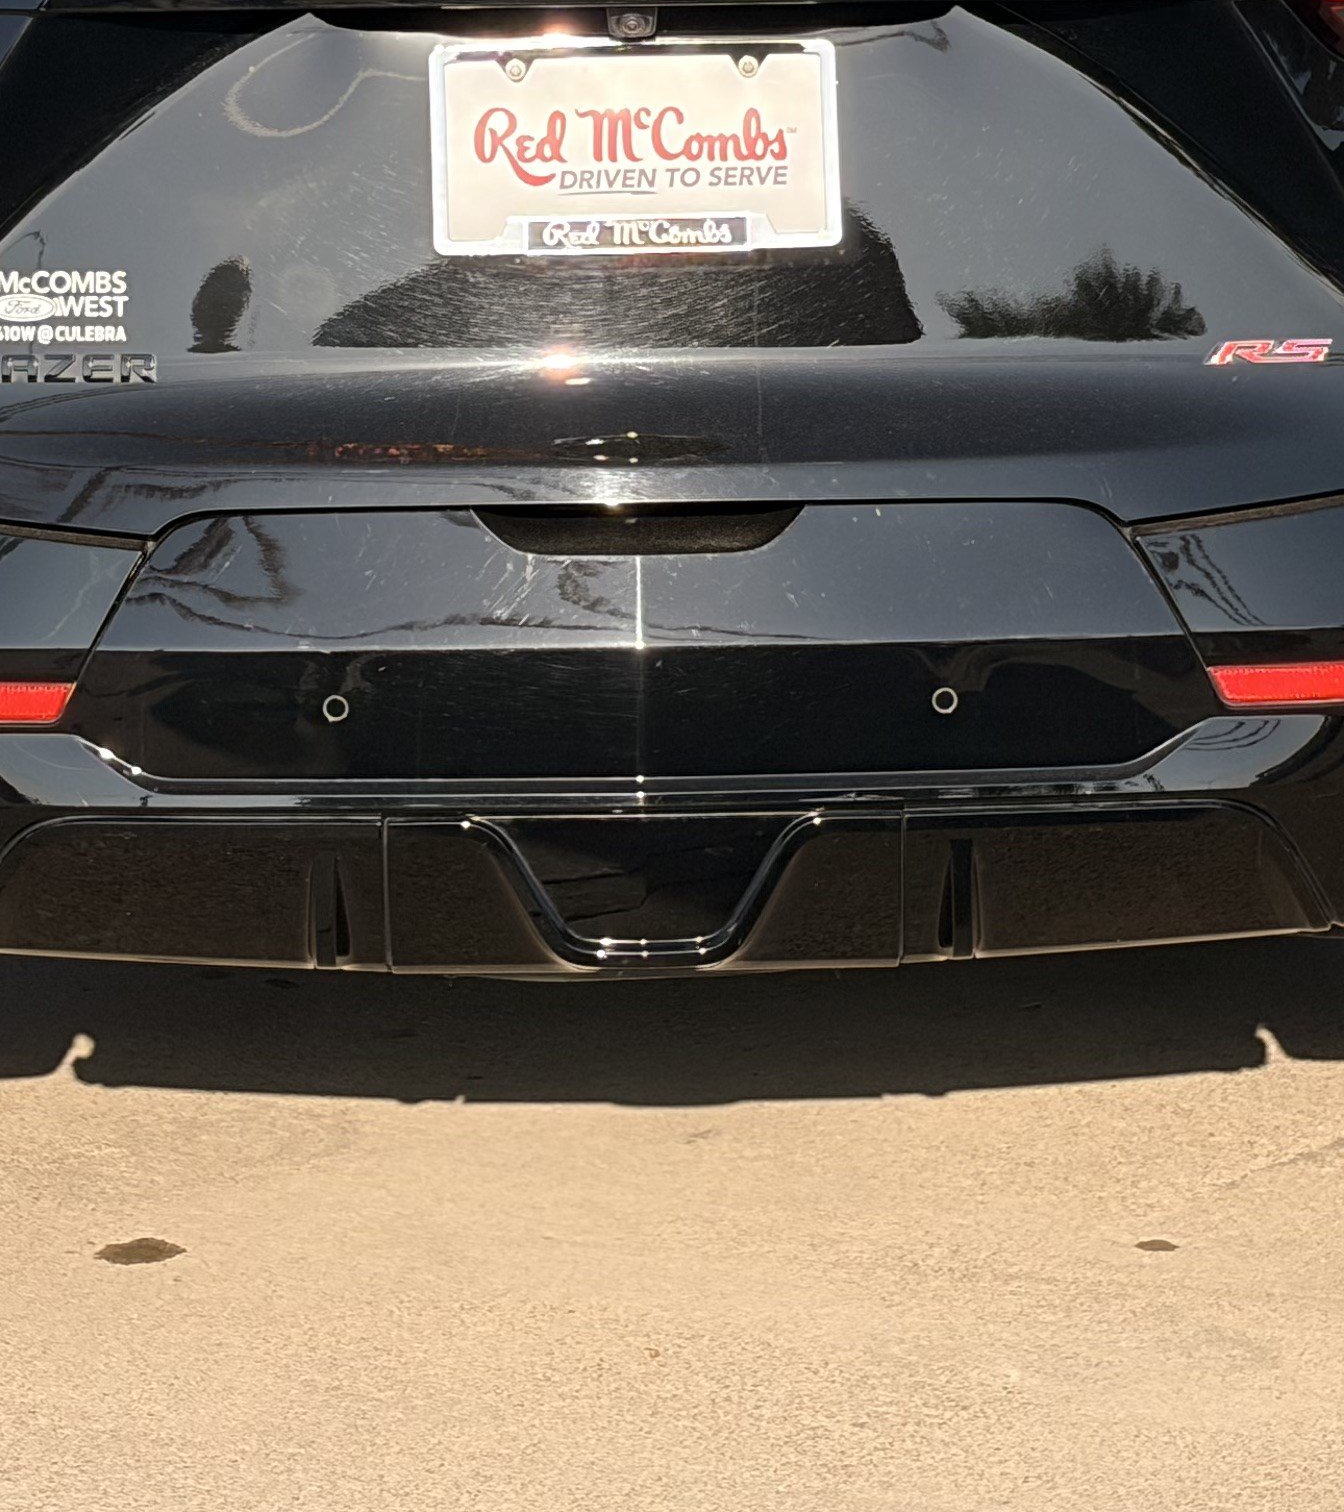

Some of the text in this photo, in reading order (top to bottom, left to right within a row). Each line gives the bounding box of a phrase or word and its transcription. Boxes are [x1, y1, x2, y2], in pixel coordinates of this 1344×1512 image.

[473, 105, 788, 187] Red McCombs
[558, 164, 789, 190] DRIVEN TO SERVE
[541, 218, 733, 250] Red McCombs
[2, 298, 42, 316] Ford
[60, 295, 130, 318] WEST
[1203, 338, 1334, 366] RS
